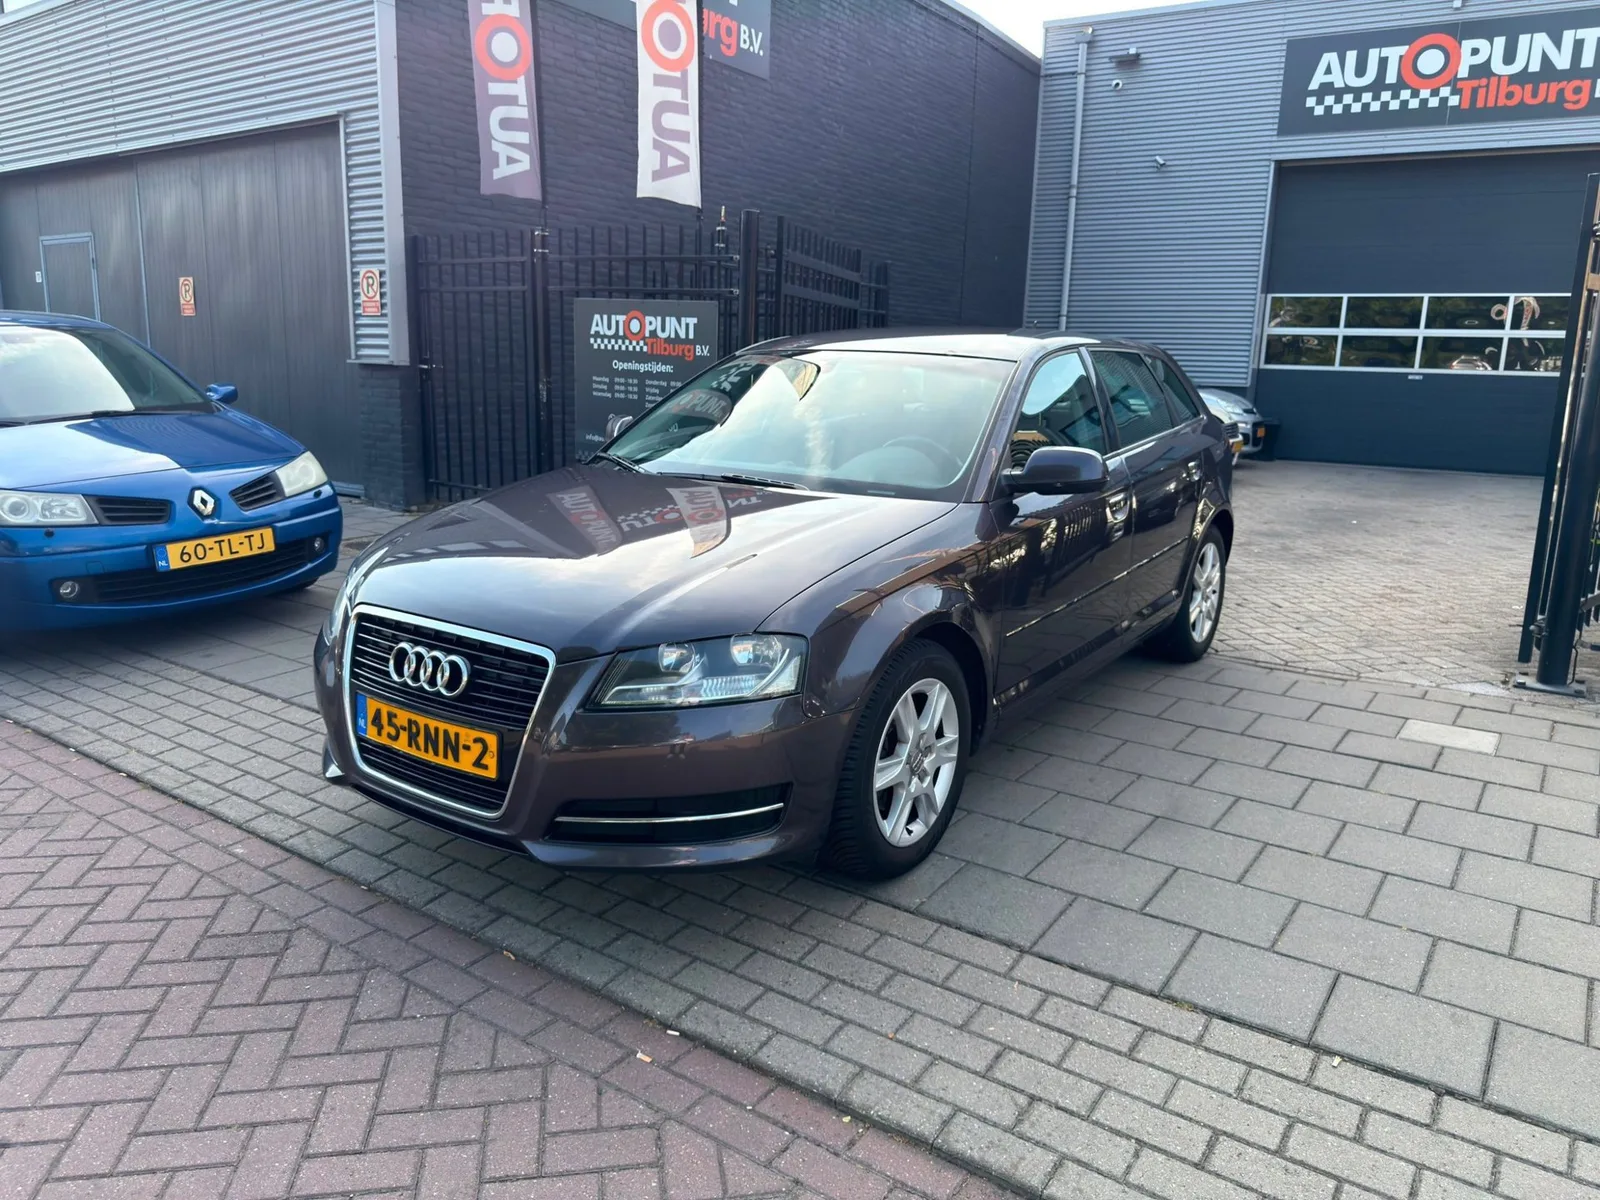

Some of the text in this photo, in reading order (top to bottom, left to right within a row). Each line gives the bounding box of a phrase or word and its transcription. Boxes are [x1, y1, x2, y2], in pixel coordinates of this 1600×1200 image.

[739, 23, 764, 57] B.V.
[1307, 27, 1600, 90] AUTOPUNT
[1456, 75, 1593, 111] Tilburg
[590, 310, 698, 341] AUTOPUNT
[646, 338, 710, 361] Tilburg B.V.
[612, 360, 674, 374] Openingstijden:
[180, 533, 265, 563] 60-TL-TJ
[371, 707, 489, 771] 45-RNN-2
